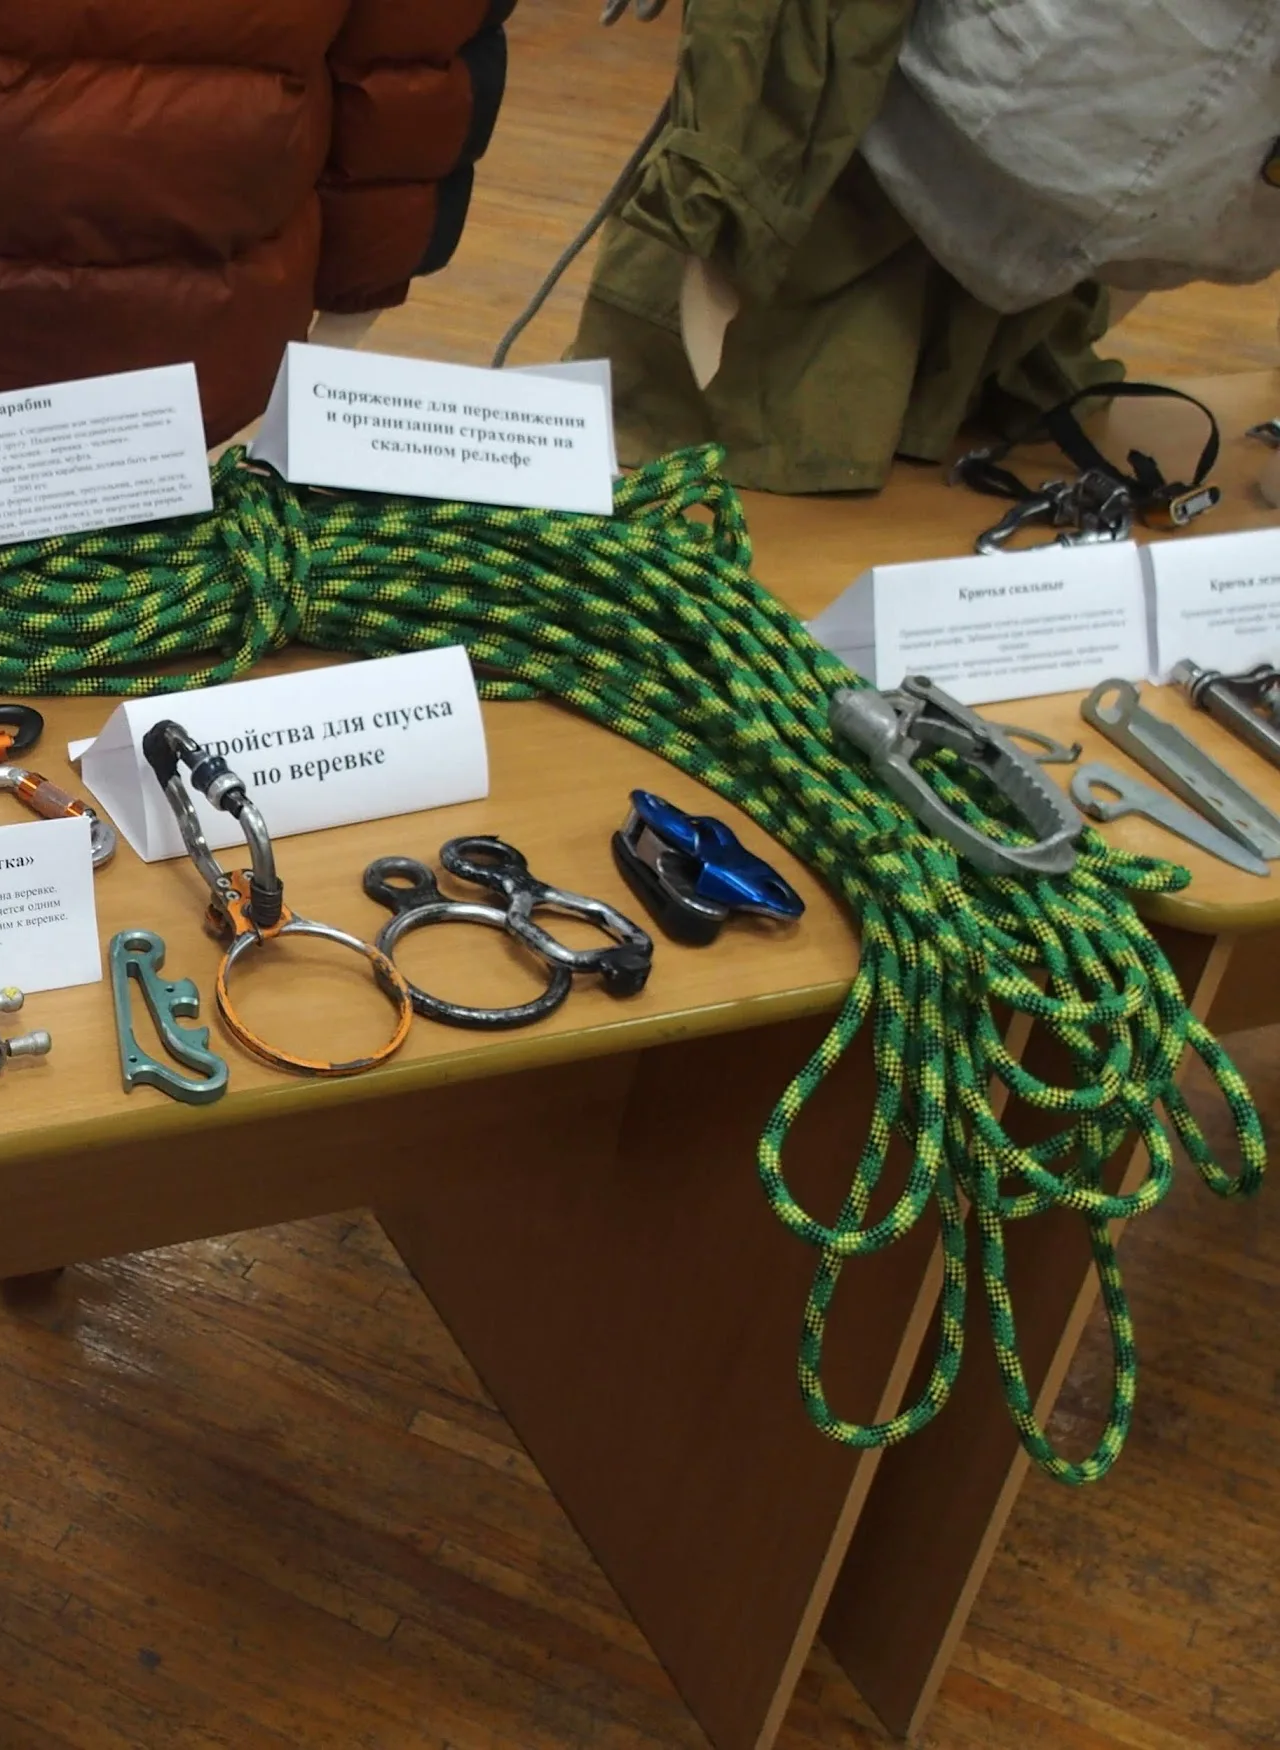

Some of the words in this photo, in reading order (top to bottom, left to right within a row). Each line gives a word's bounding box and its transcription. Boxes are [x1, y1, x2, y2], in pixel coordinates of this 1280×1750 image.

[312, 384, 421, 409] Снаряжение
[426, 400, 457, 413] для
[461, 405, 584, 429] передвижения
[325, 411, 336, 421] и
[341, 413, 454, 435] организации
[458, 427, 547, 446] страховки
[552, 438, 573, 449] на
[370, 439, 455, 457] скальном
[460, 449, 530, 468] рельефе
[957, 587, 1006, 601] Крючья
[1008, 581, 1063, 594] скальные
[199, 725, 316, 758] тройства
[322, 716, 366, 742] для
[372, 701, 453, 730] спуска
[251, 767, 281, 787] по
[287, 748, 385, 781] веревке
[0, 892, 12, 901] на
[28, 899, 61, 912] одним
